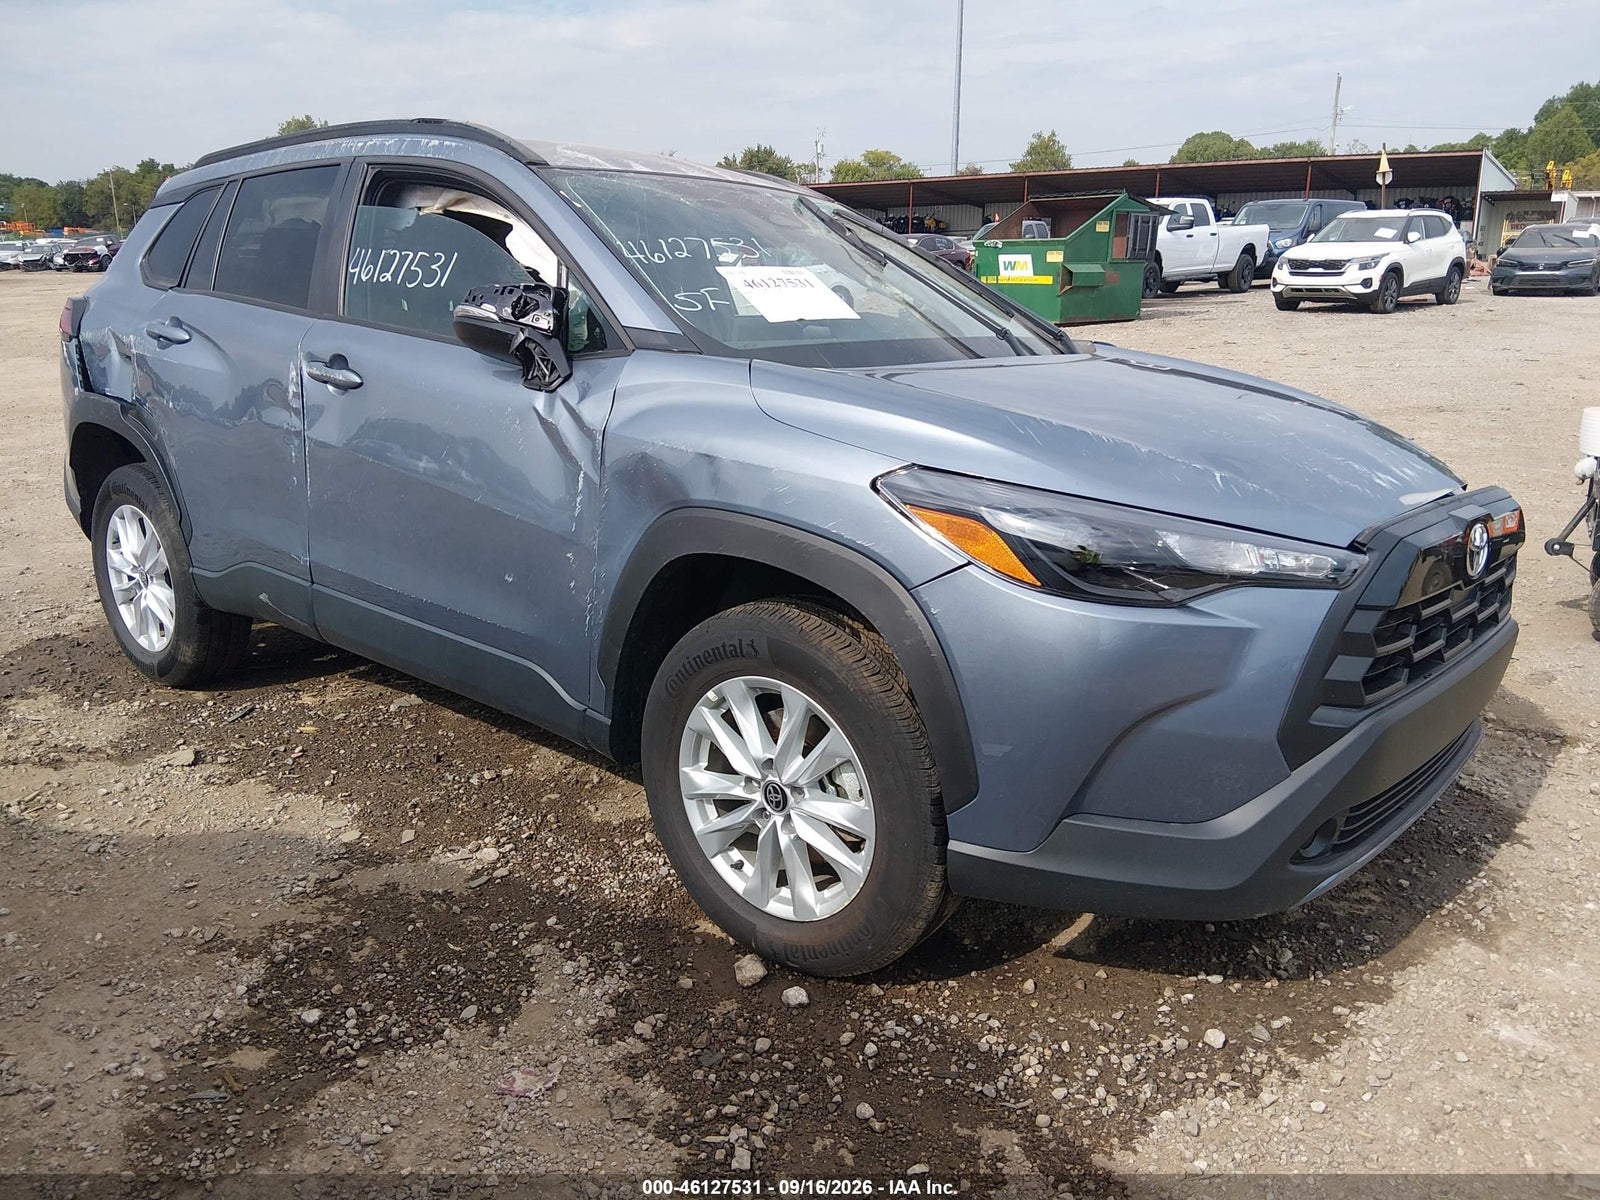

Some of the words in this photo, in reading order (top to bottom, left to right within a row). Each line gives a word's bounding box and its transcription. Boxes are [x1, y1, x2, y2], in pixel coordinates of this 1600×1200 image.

[616, 236, 772, 264] 46127531
[349, 247, 458, 288] 46127531
[1003, 260, 1029, 271] WM
[743, 277, 815, 289] 46127531
[664, 638, 746, 699] Continental
